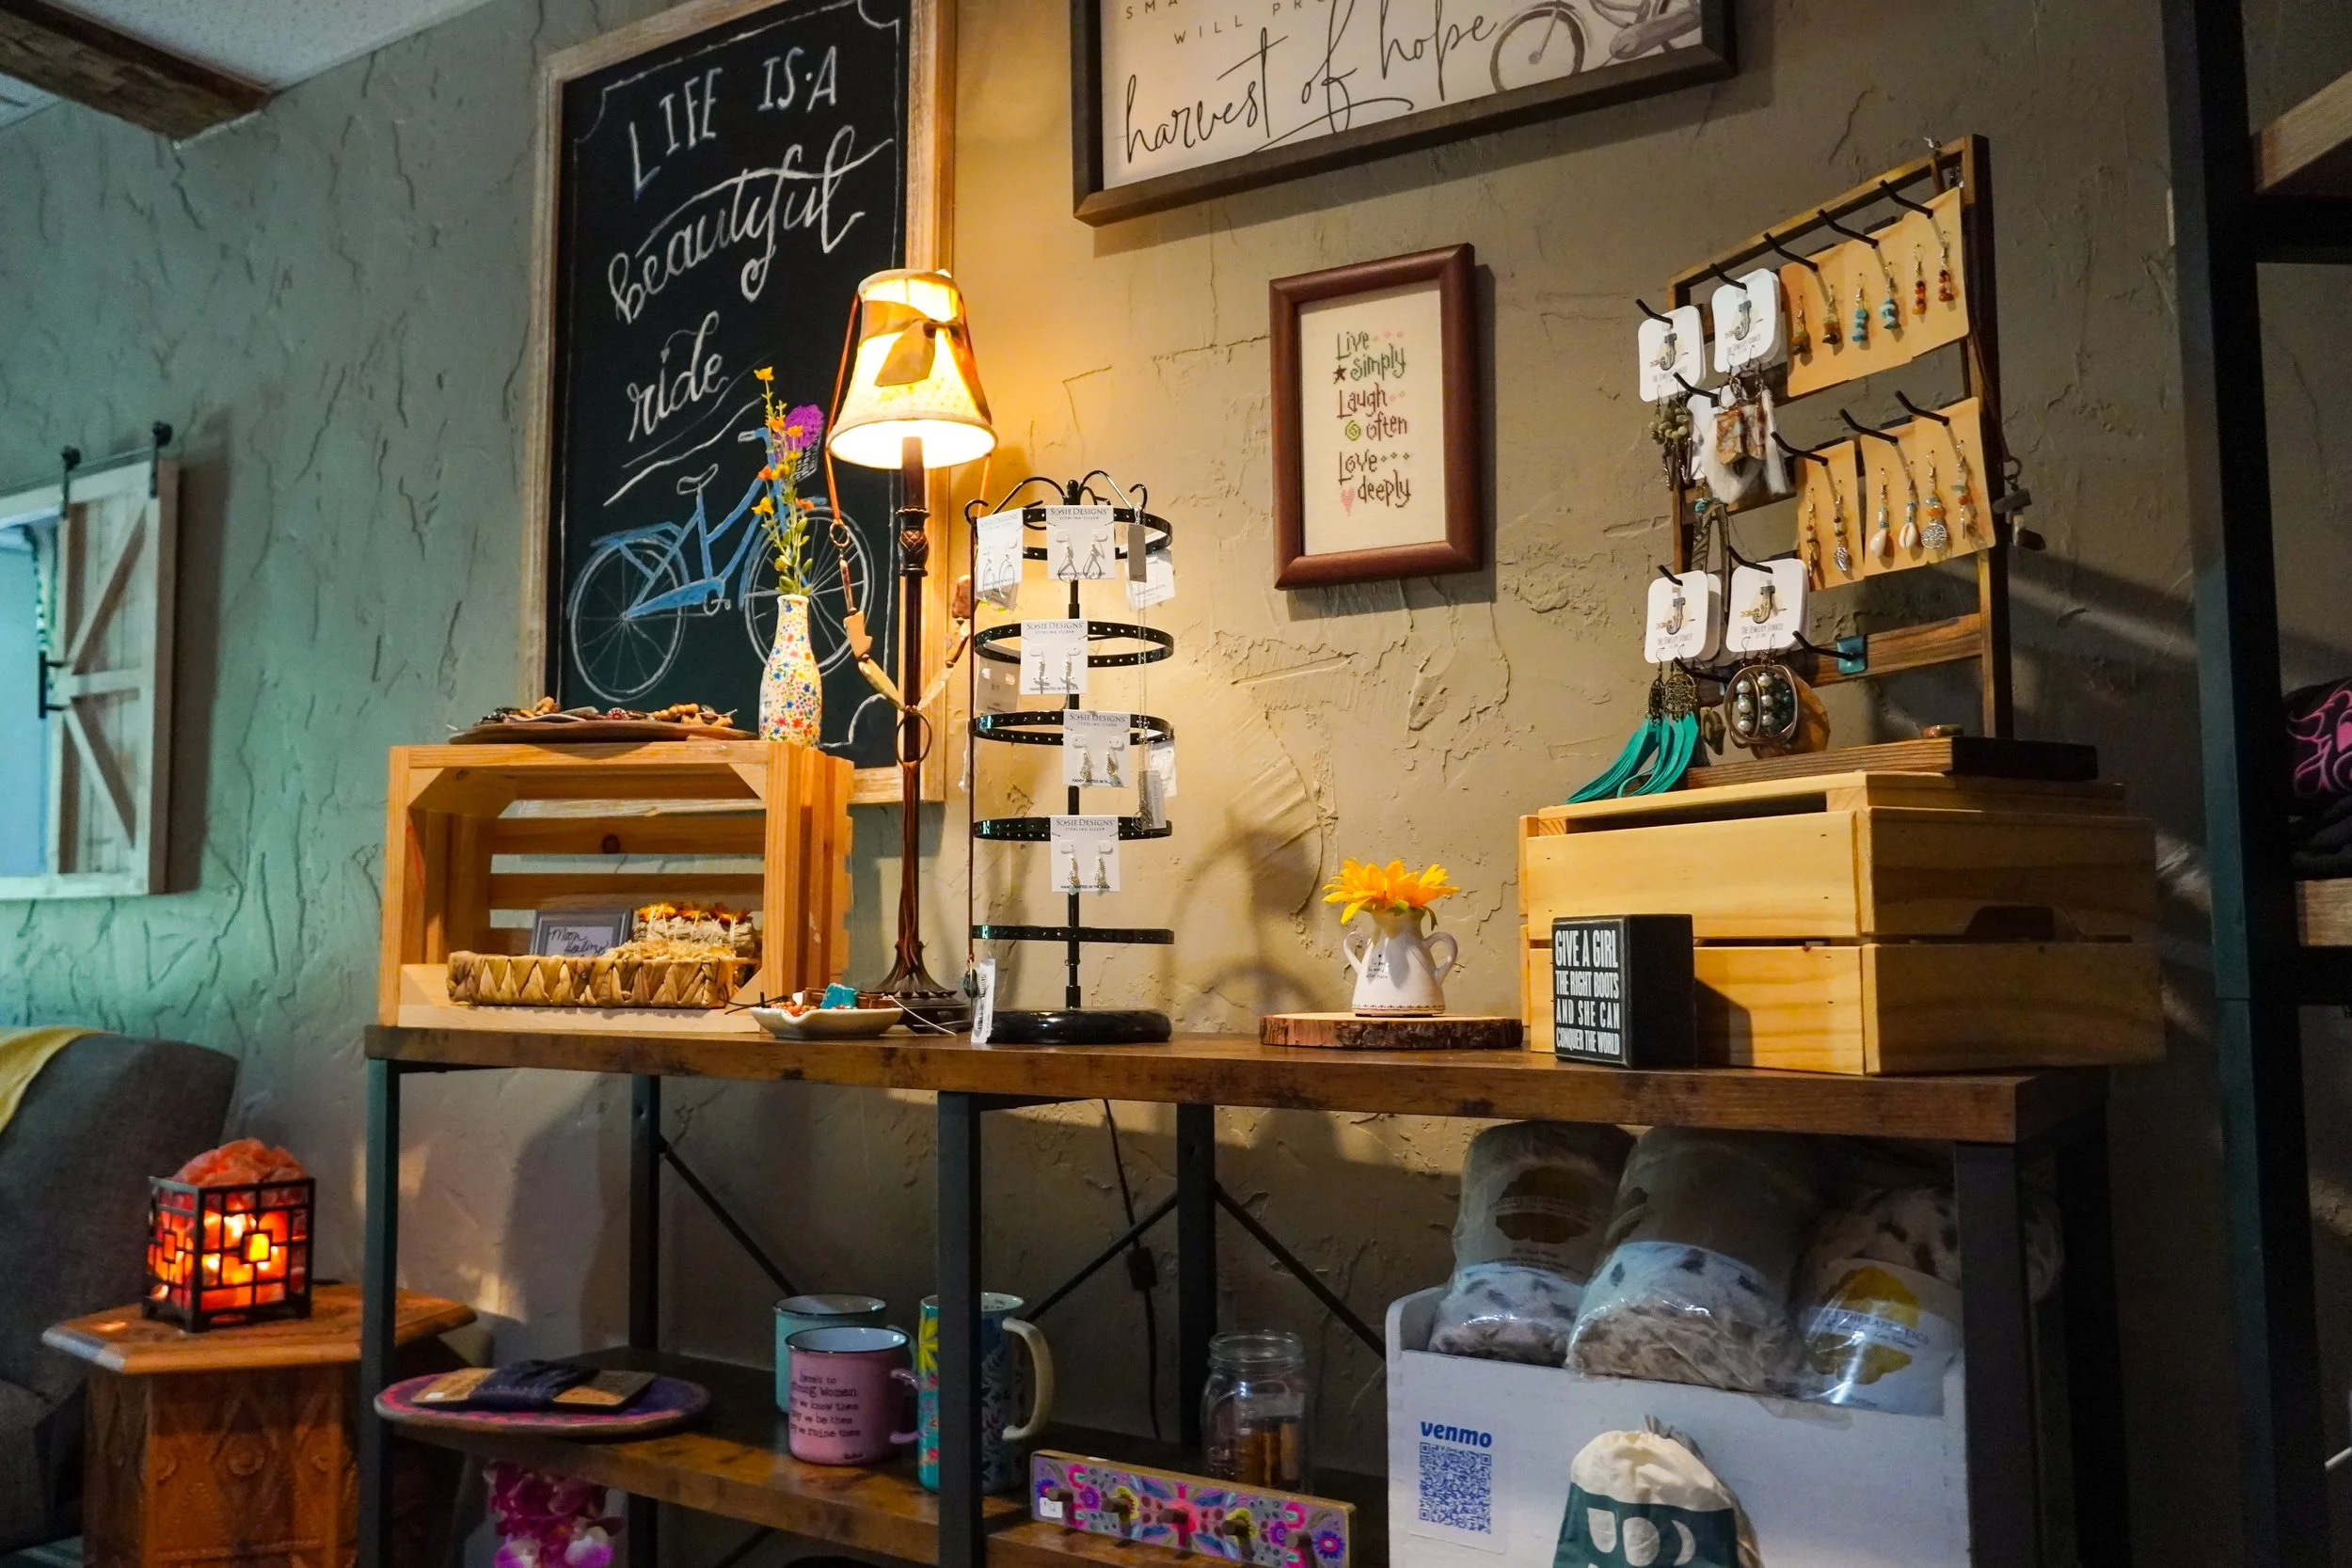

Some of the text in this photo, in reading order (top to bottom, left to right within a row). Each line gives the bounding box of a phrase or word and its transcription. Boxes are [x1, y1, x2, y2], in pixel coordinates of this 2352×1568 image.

[1174, 0, 1326, 44] WILL PR
[1125, 27, 1290, 165] harvest
[1379, 0, 1499, 102] hope
[628, 68, 723, 199] LIFE
[607, 123, 894, 324] beautiful
[628, 310, 729, 444] ride
[1351, 343, 1406, 381] simply
[1367, 411, 1407, 442] often
[1358, 469, 1411, 508] deeply
[1555, 929, 1618, 969] GIVE A GIRL
[1555, 970, 1619, 1000] THE RIGHT BOOTS
[1556, 999, 1620, 1029] AND SHE CAN
[1556, 1026, 1619, 1055] CONQUER THE WORLD
[1420, 1420, 1493, 1449] venmo
